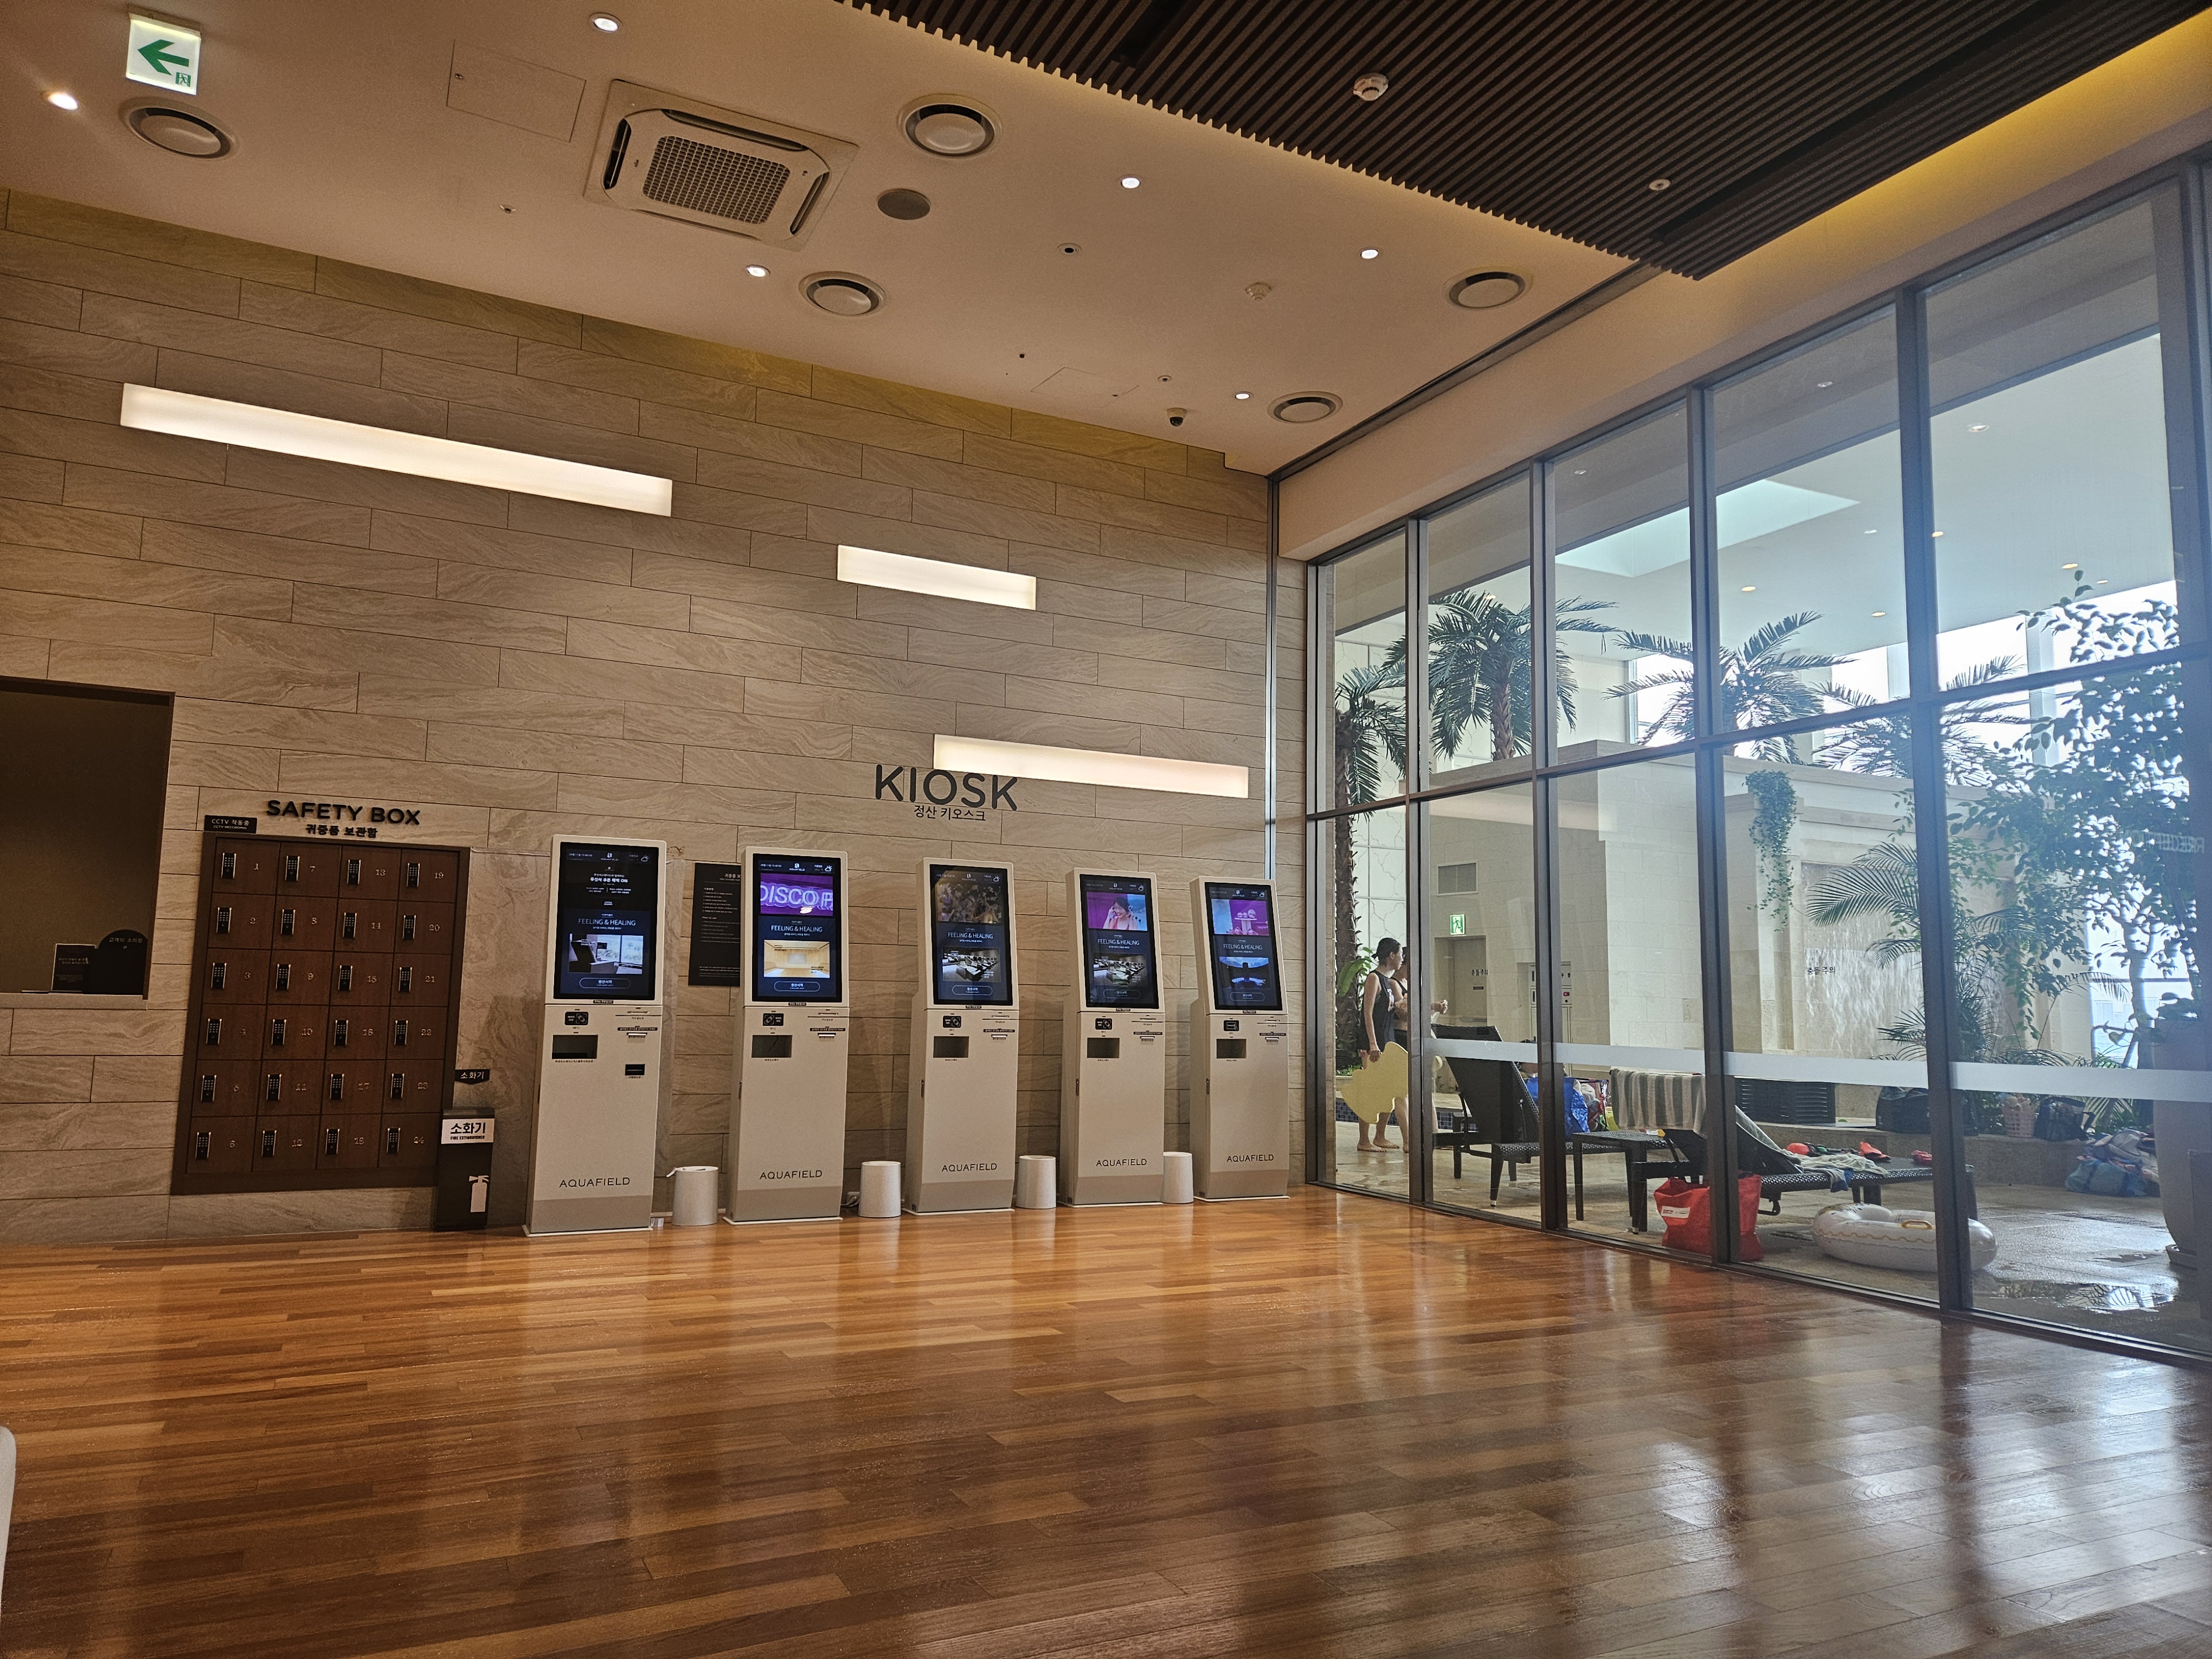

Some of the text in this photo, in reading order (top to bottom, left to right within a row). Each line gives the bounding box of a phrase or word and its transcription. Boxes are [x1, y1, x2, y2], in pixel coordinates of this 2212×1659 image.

[875, 764, 1018, 811] KIOSK
[267, 799, 420, 825] SAFETY BOX
[914, 805, 986, 821] 정산 키오스크
[305, 823, 378, 838] 귀중품 보관함
[760, 885, 819, 905] DISCO
[1807, 966, 1835, 975] 충돌 주의
[460, 1071, 484, 1079] 소화기
[450, 1122, 486, 1134] 소화기
[1096, 1159, 1147, 1167] AQUAFIELD
[1227, 1154, 1274, 1162] AQUAFIELD
[941, 1163, 997, 1172] AQUAFIELD
[759, 1170, 822, 1180] AQUAFIELD
[559, 1177, 630, 1188] AQUAFIELD
